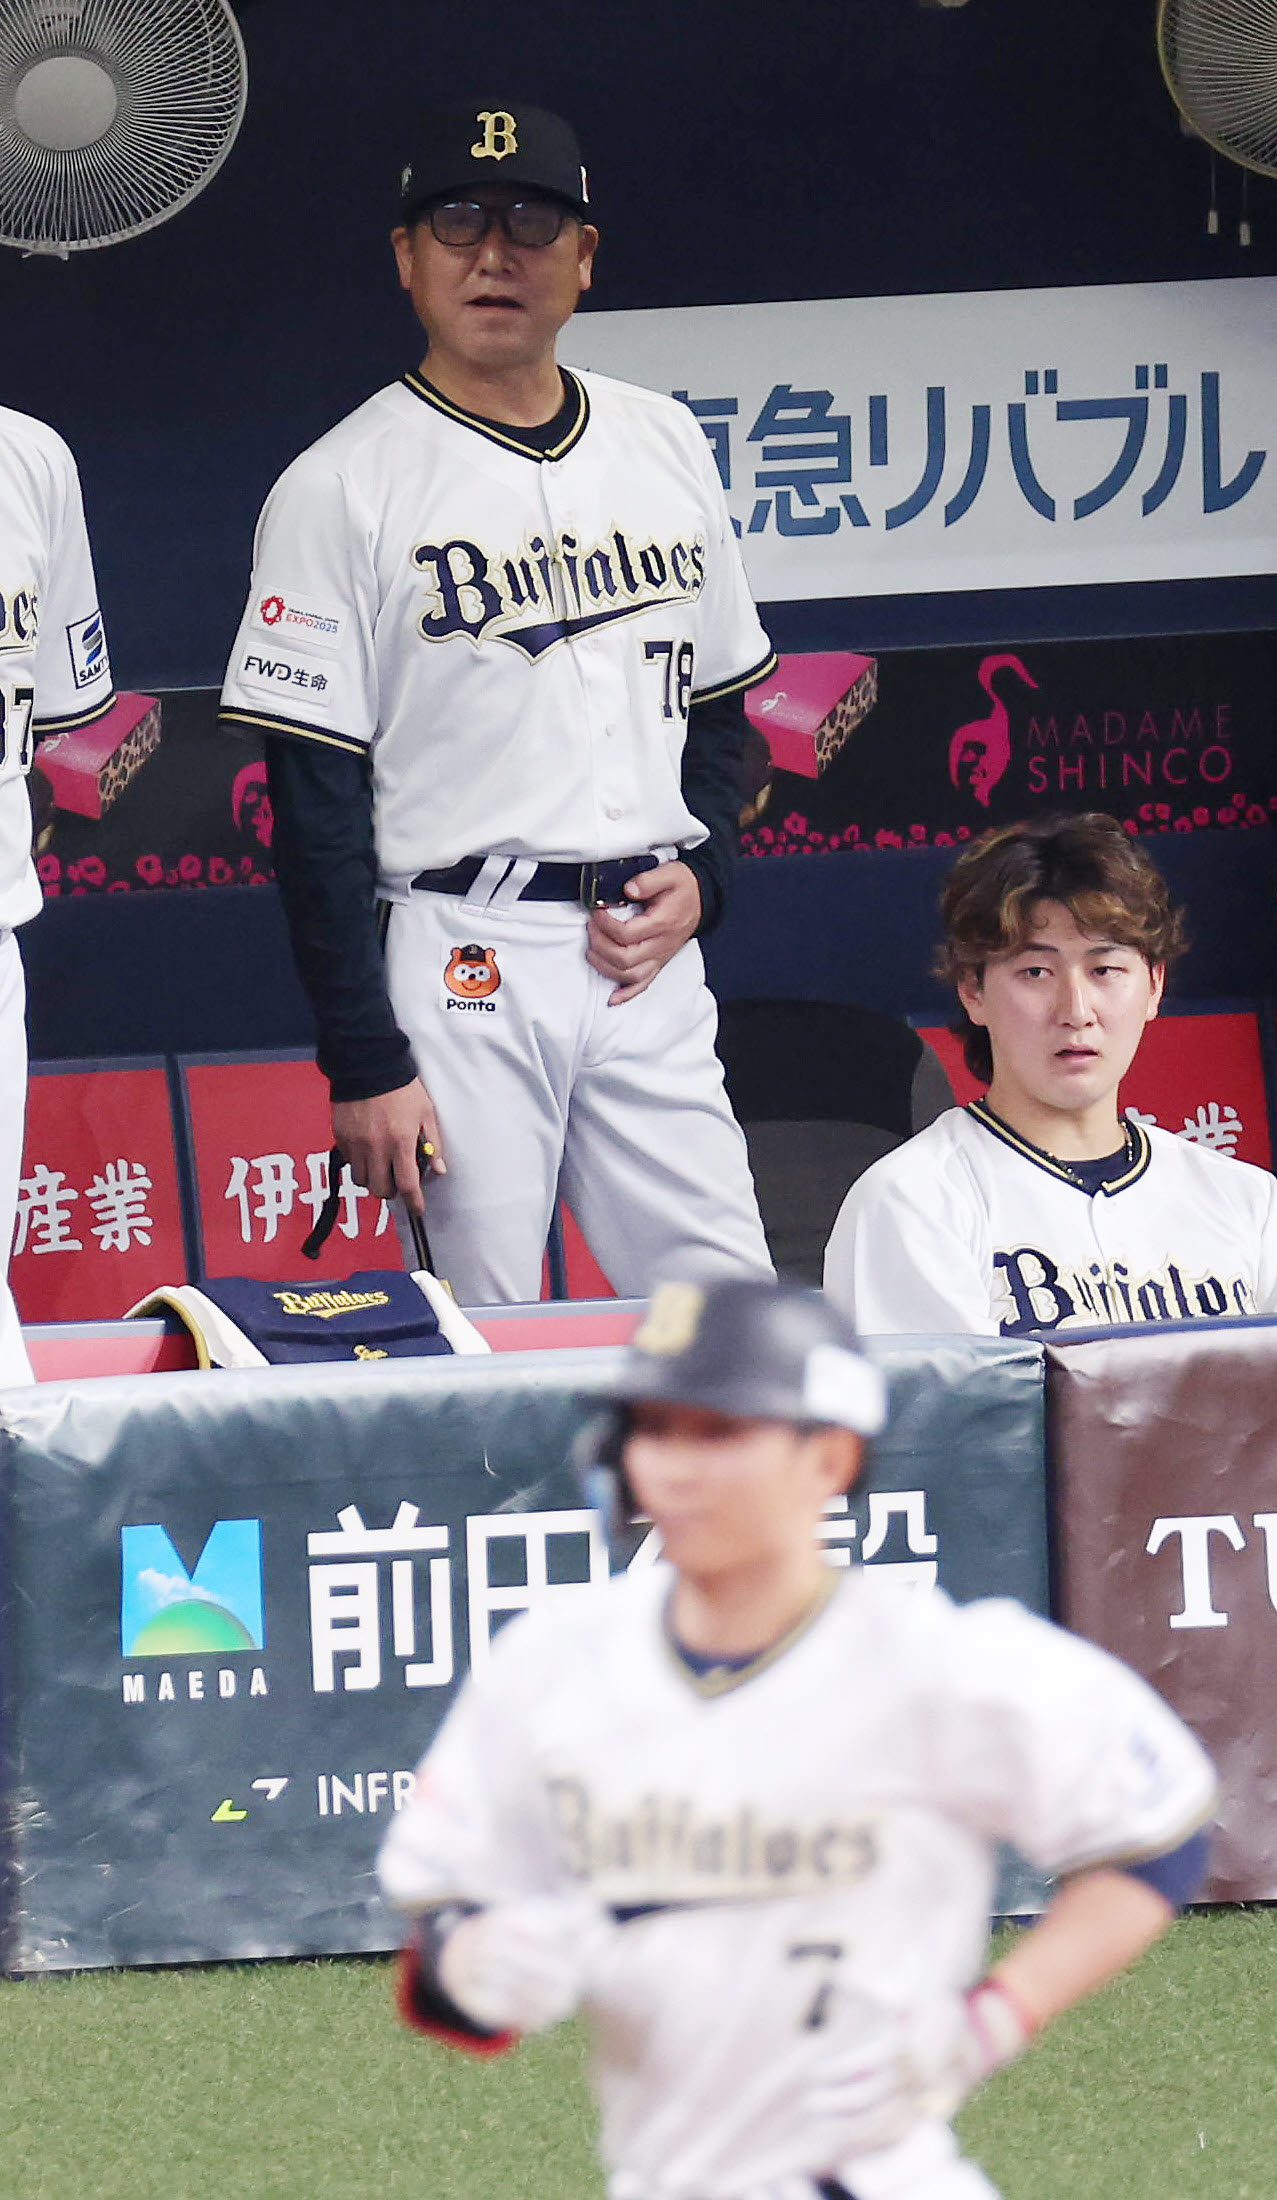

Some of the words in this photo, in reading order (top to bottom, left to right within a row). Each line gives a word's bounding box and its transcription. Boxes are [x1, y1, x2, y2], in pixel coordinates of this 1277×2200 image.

[470, 110, 518, 161] B
[409, 520, 706, 649] Buffaloes
[244, 655, 328, 691] FWD生命
[640, 637, 694, 723] 78
[1027, 703, 1233, 747] MADAME
[1028, 746, 1232, 793] SHINCO
[446, 998, 496, 1012] Ponta
[224, 1150, 391, 1244] 伊丹
[1145, 1512, 1277, 1629] T
[122, 1667, 268, 1703] MAEDA
[786, 1938, 846, 2034] 7
